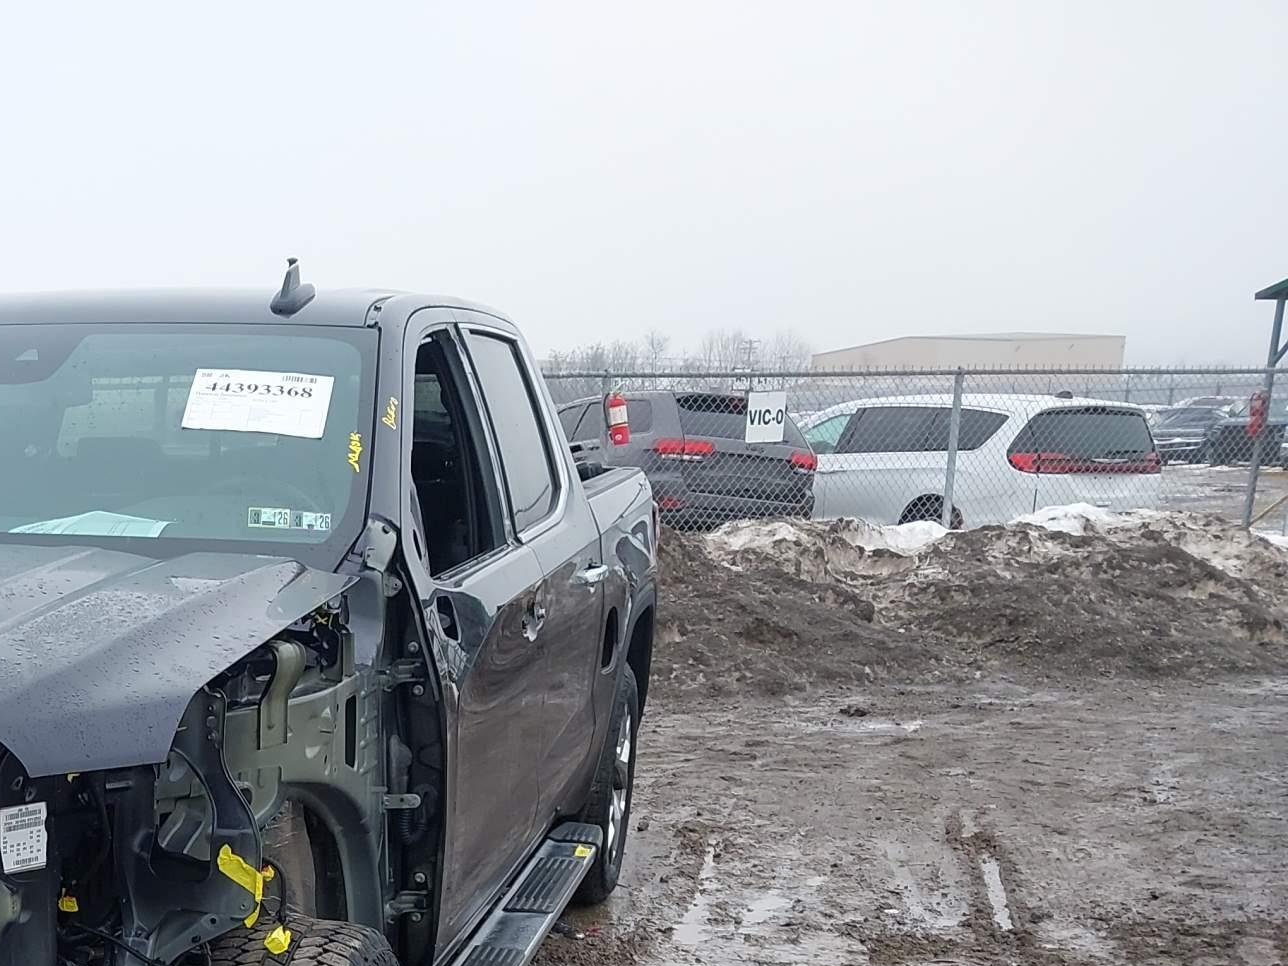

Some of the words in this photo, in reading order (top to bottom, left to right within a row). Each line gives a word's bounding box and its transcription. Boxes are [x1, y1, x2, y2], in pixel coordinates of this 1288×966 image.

[205, 381, 313, 398] 44393368
[277, 511, 289, 526] 26
[319, 515, 330, 529] 26
